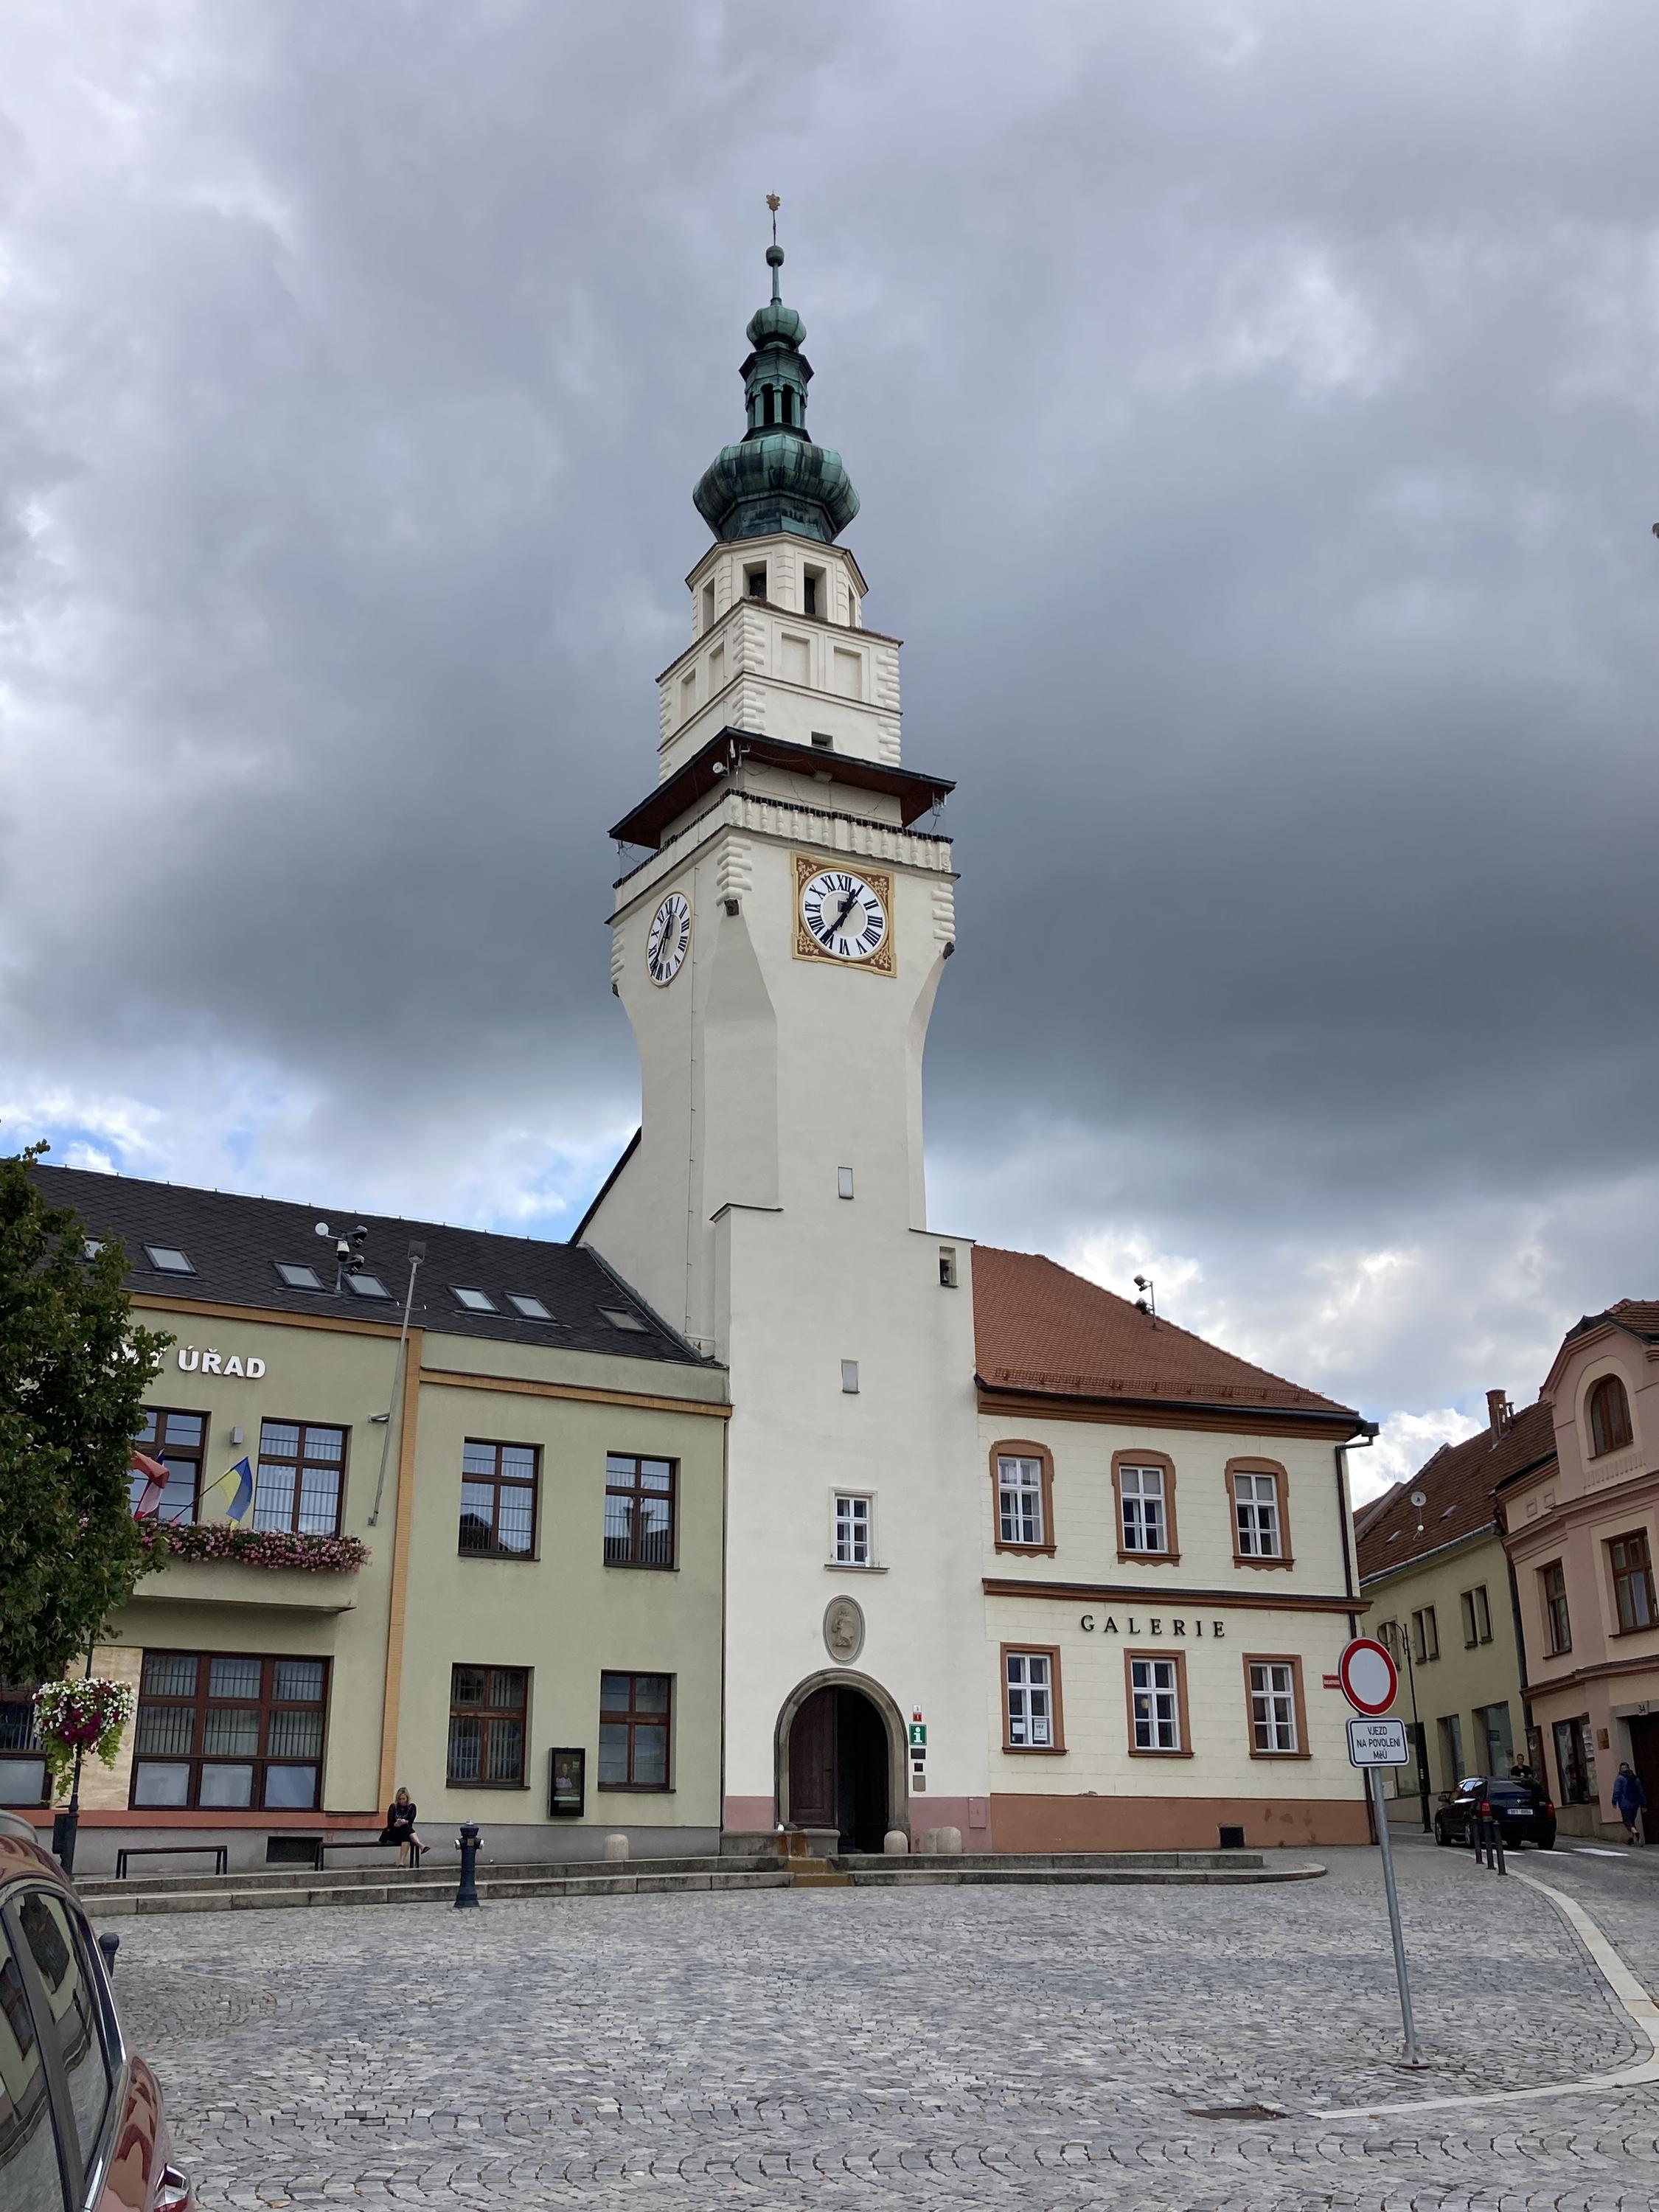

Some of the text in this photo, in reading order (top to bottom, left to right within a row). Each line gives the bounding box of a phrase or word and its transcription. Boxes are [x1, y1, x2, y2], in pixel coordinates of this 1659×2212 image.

[821, 874, 836, 893] XI
[837, 874, 852, 891] XII
[809, 885, 827, 900] X
[804, 901, 821, 913] IX
[863, 899, 880, 911] II
[681, 918, 690, 933] III
[867, 915, 883, 929] III
[650, 928, 660, 938] X
[839, 938, 851, 956] VI
[855, 939, 867, 955] V
[674, 954, 681, 968] V
[178, 1345, 266, 1379] ÚŘAD
[1080, 1615, 1225, 1638] GALERIE
[914, 1726, 923, 1743] i
[1367, 1726, 1388, 1736] VJEZD
[1357, 1736, 1401, 1748] NA POVOLENÍ
[1373, 1748, 1388, 1759] MěÚ
